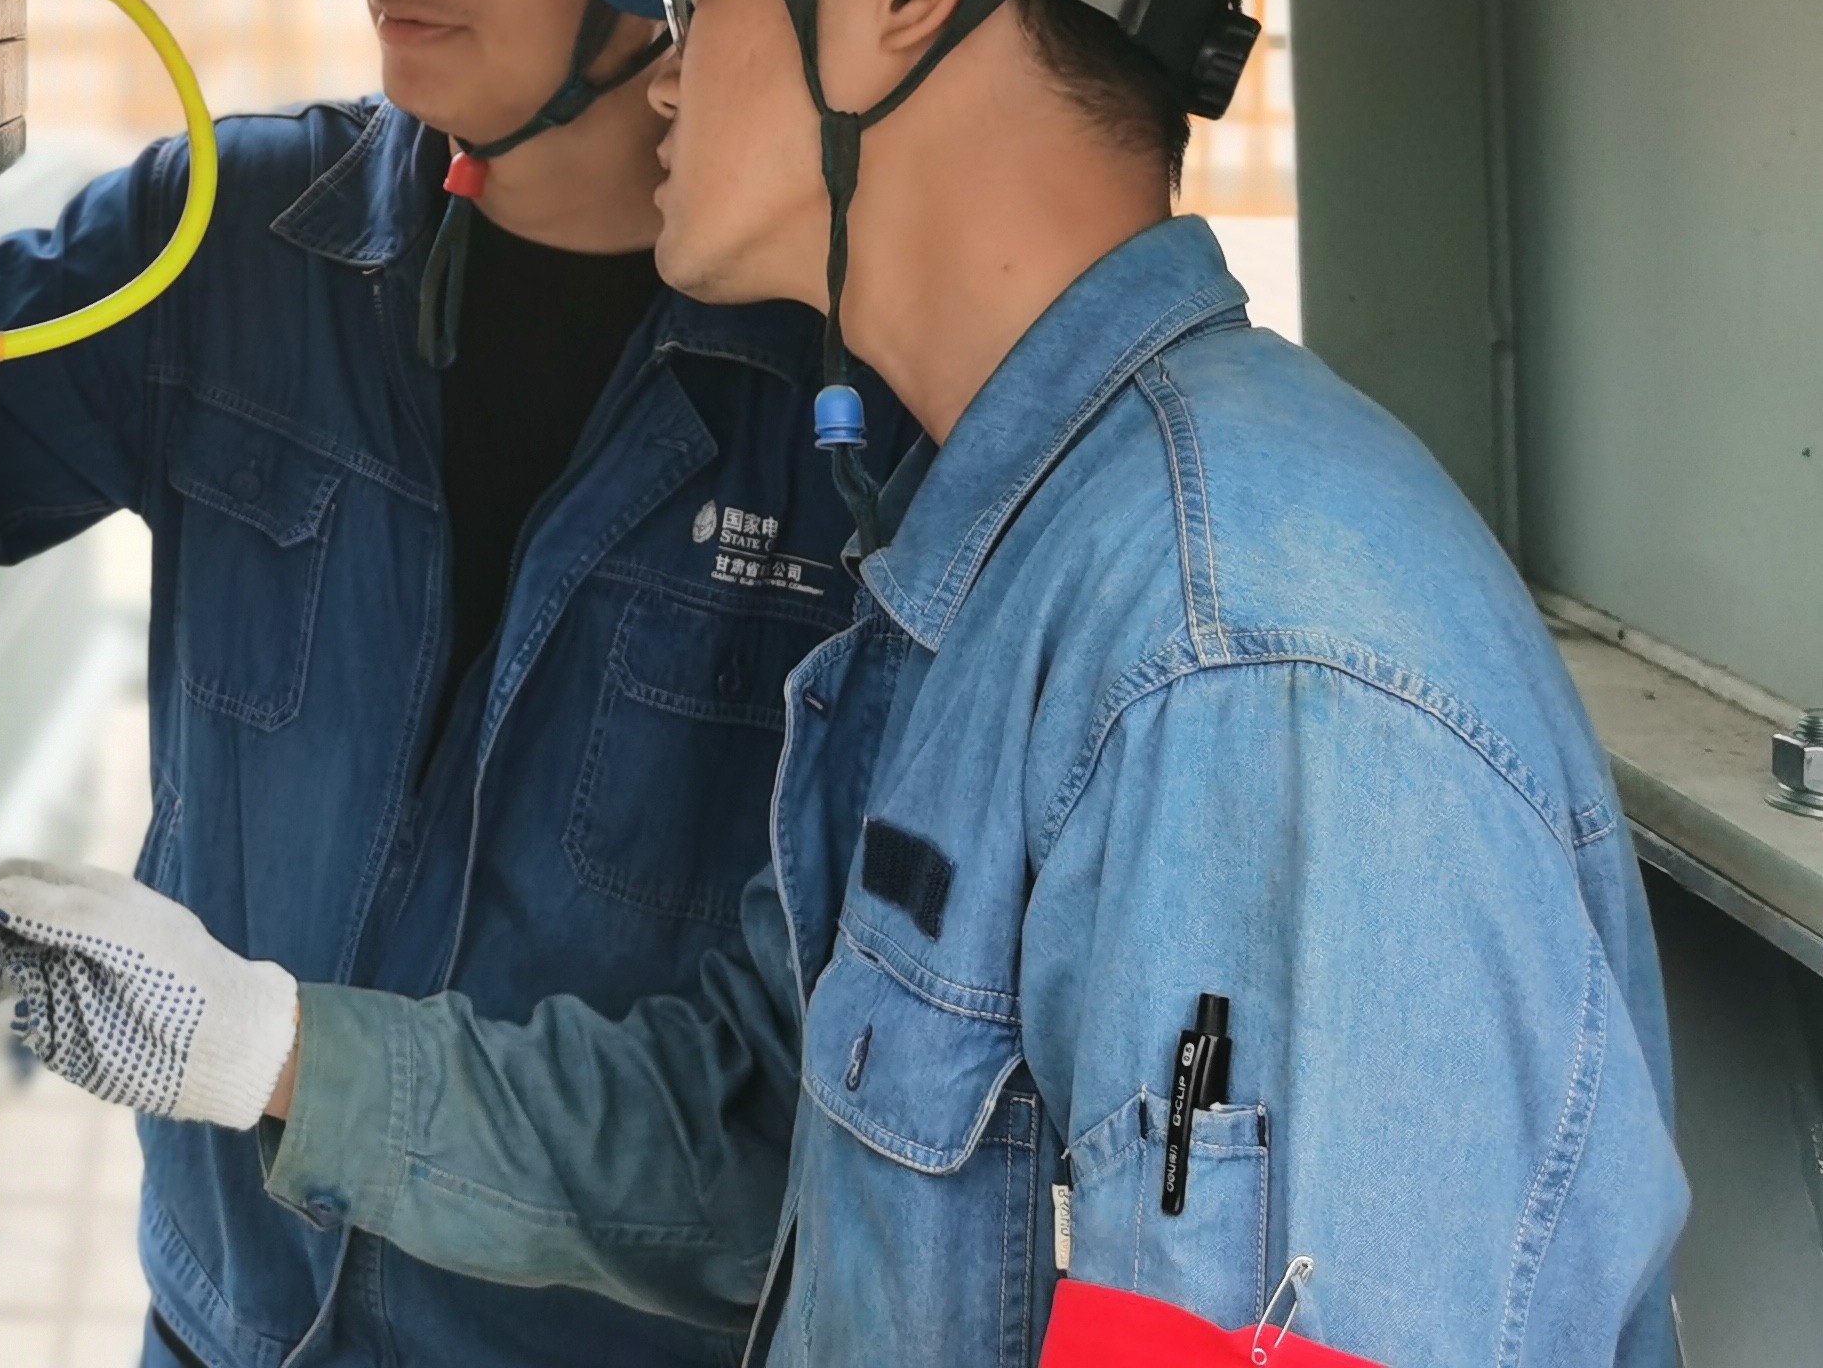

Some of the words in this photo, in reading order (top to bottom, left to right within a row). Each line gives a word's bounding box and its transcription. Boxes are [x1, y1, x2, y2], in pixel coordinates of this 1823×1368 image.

[721, 506, 779, 538] 国家电
[719, 529, 761, 550] STATE
[715, 554, 802, 582] 甘肃省公司
